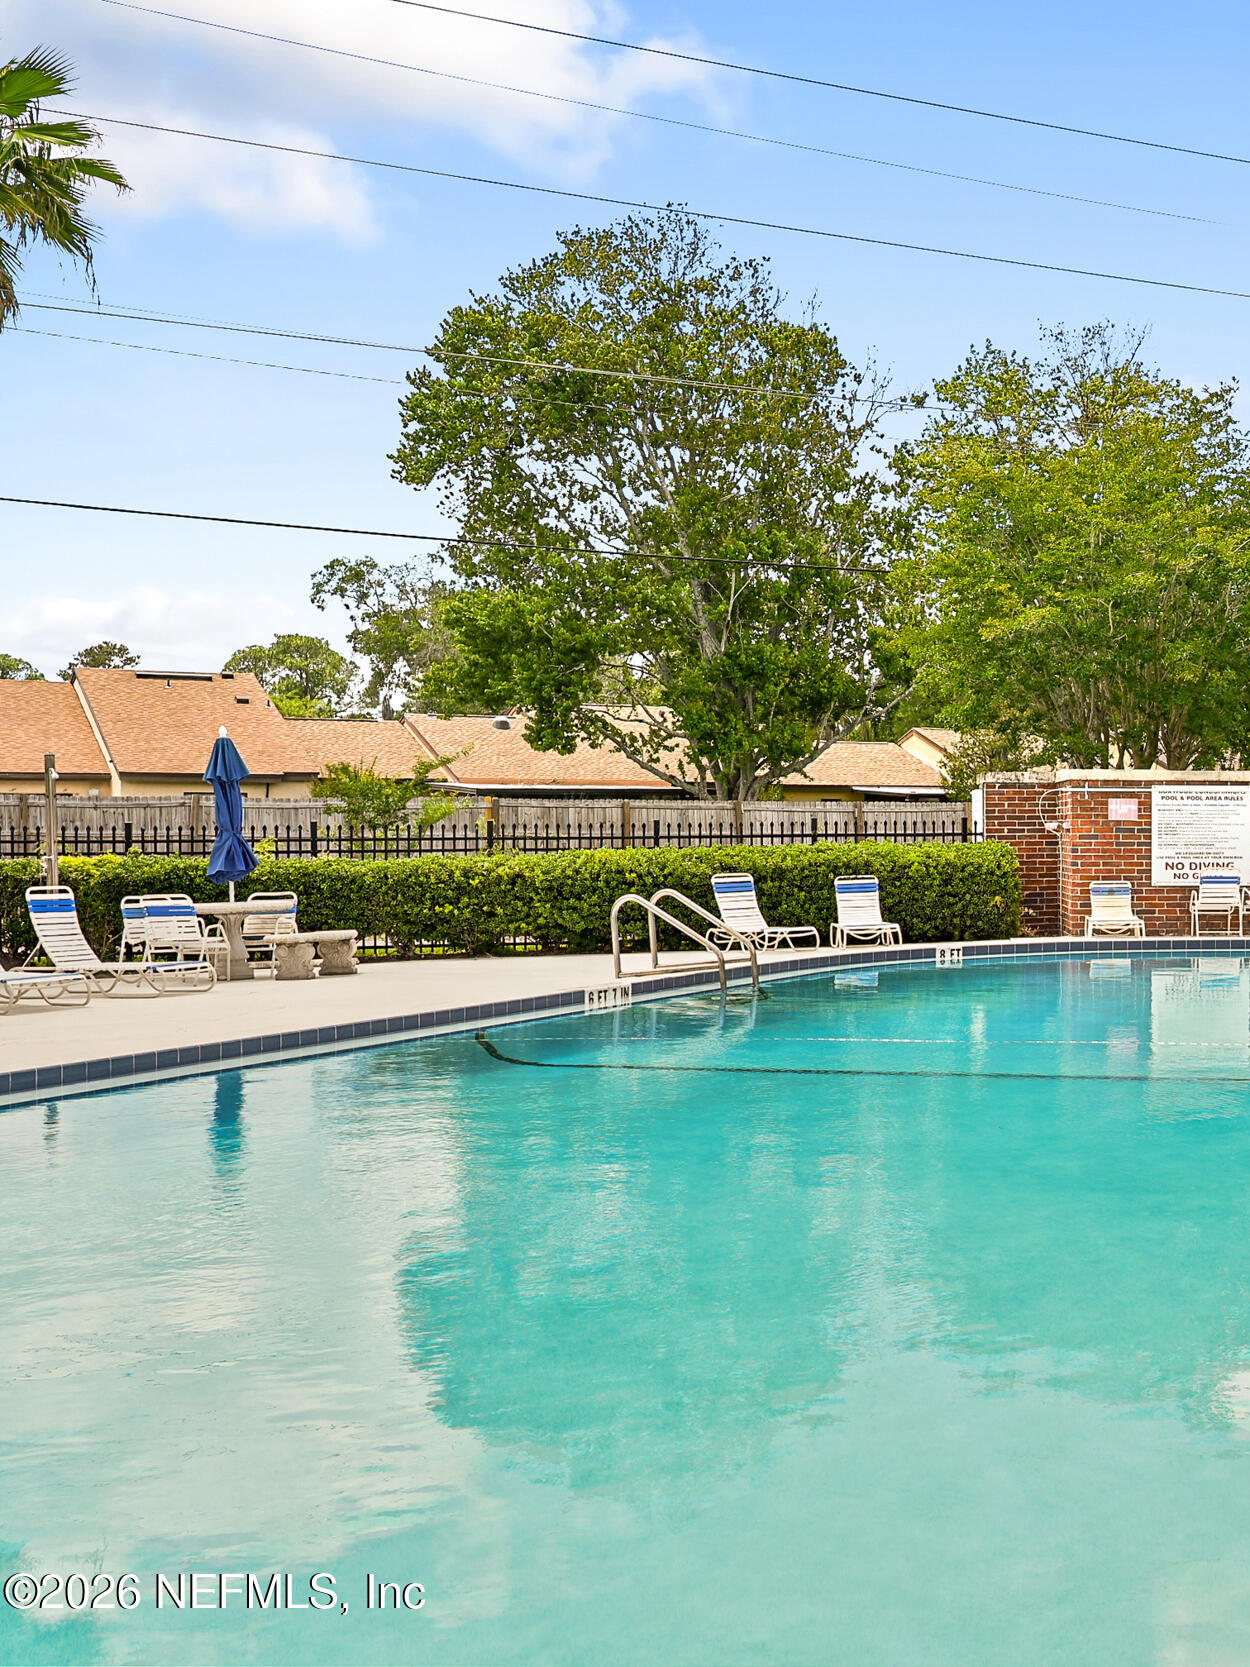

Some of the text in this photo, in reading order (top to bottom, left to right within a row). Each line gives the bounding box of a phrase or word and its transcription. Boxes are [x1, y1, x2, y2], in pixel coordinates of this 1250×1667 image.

[1165, 862, 1235, 870] NO DIVING
[939, 948, 961, 959] 8 FT
[598, 989, 608, 1005] FT
[612, 988, 617, 1002] 7
[621, 986, 630, 1000] IN
